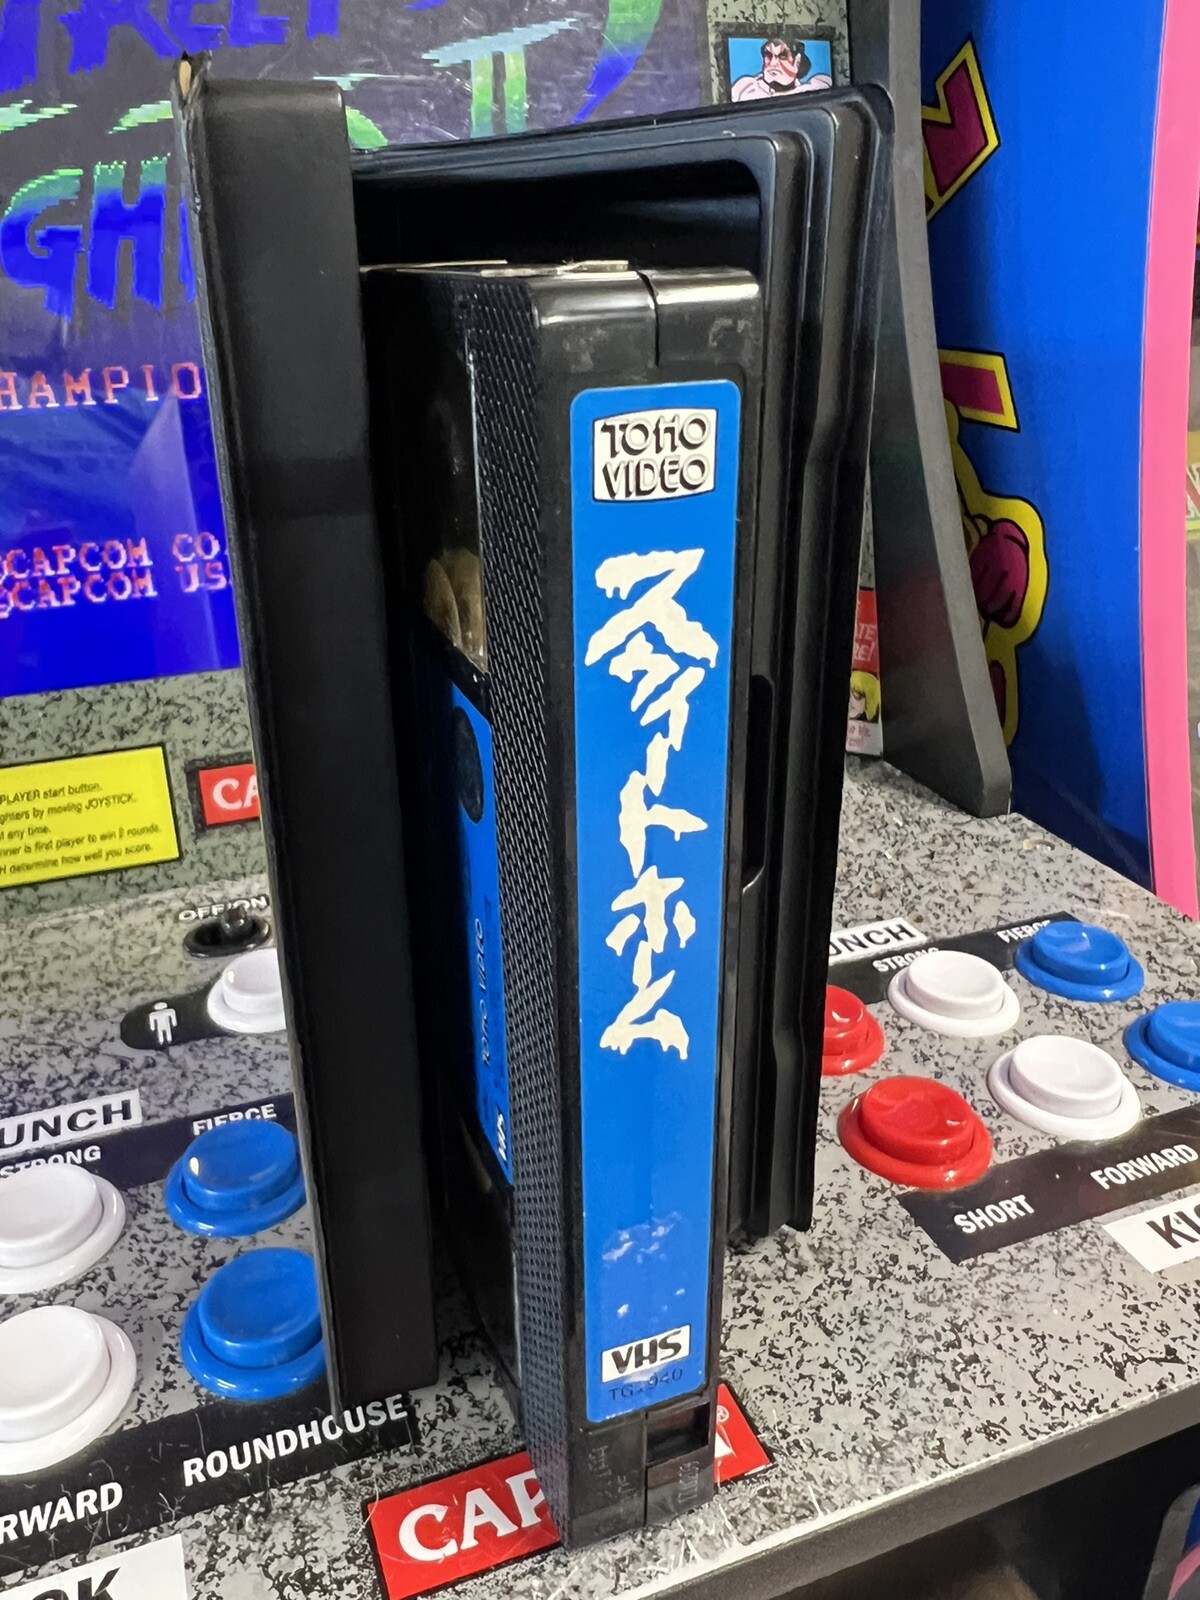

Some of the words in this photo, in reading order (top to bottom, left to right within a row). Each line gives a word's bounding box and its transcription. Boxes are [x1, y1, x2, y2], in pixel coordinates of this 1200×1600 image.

[600, 413, 711, 458] TOHO
[602, 453, 710, 499] VIDEO
[33, 807, 44, 820] by
[47, 802, 82, 814] moving
[43, 782, 66, 799] start
[9, 858, 59, 874] determine
[61, 855, 81, 865] how
[84, 848, 103, 861] well
[105, 848, 122, 861] you
[35, 839, 53, 851] first
[56, 836, 85, 851] player
[88, 834, 97, 843] to
[100, 830, 116, 841] win
[997, 920, 1050, 943] FIERC
[1090, 1143, 1199, 1190] FORWARD
[953, 1194, 1035, 1234] SHORT
[1146, 1203, 1200, 1249] KI
[611, 1330, 682, 1374] VHS
[183, 1394, 408, 1487] ROUNDHOUSE
